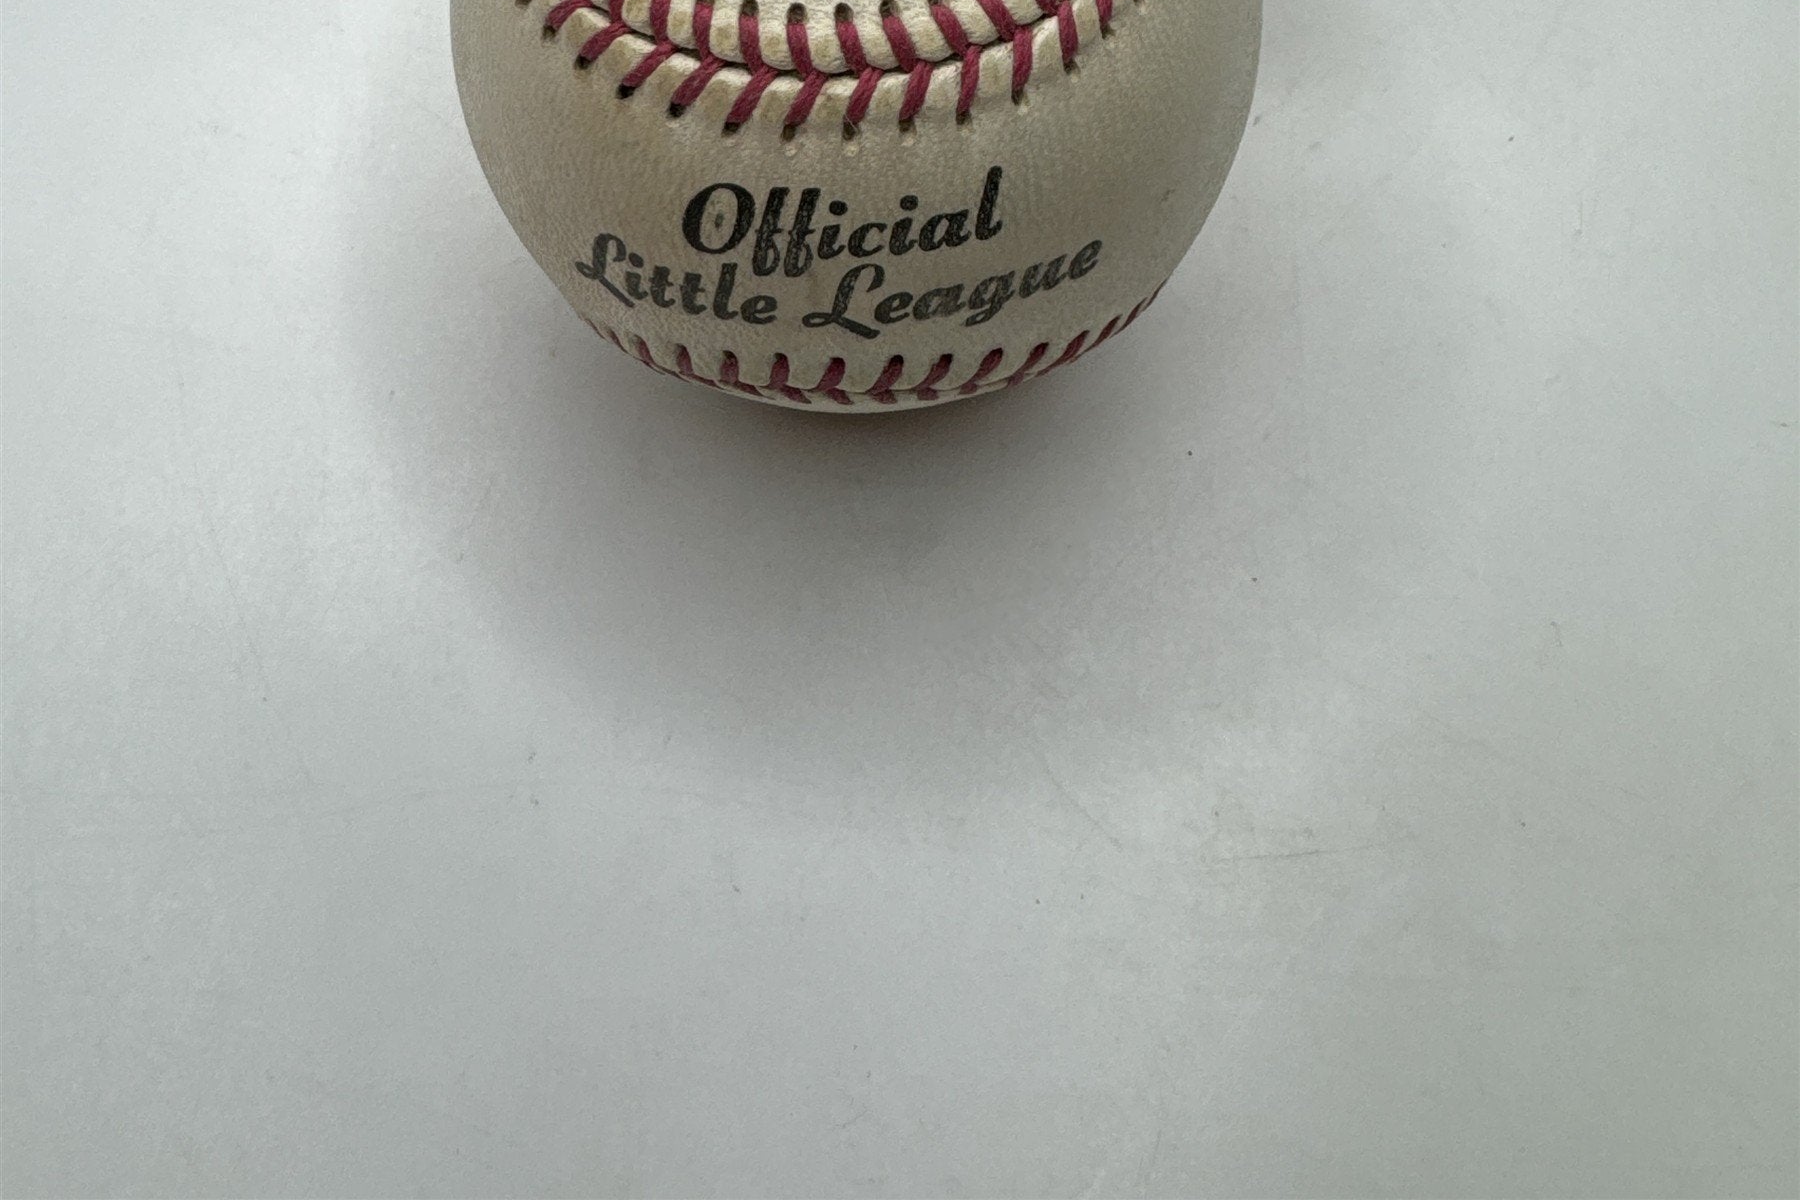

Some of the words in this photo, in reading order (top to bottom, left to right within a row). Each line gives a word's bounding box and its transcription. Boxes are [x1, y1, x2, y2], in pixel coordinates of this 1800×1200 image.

[681, 166, 1003, 278] Official
[575, 233, 778, 326] Little
[801, 240, 1103, 340] League
